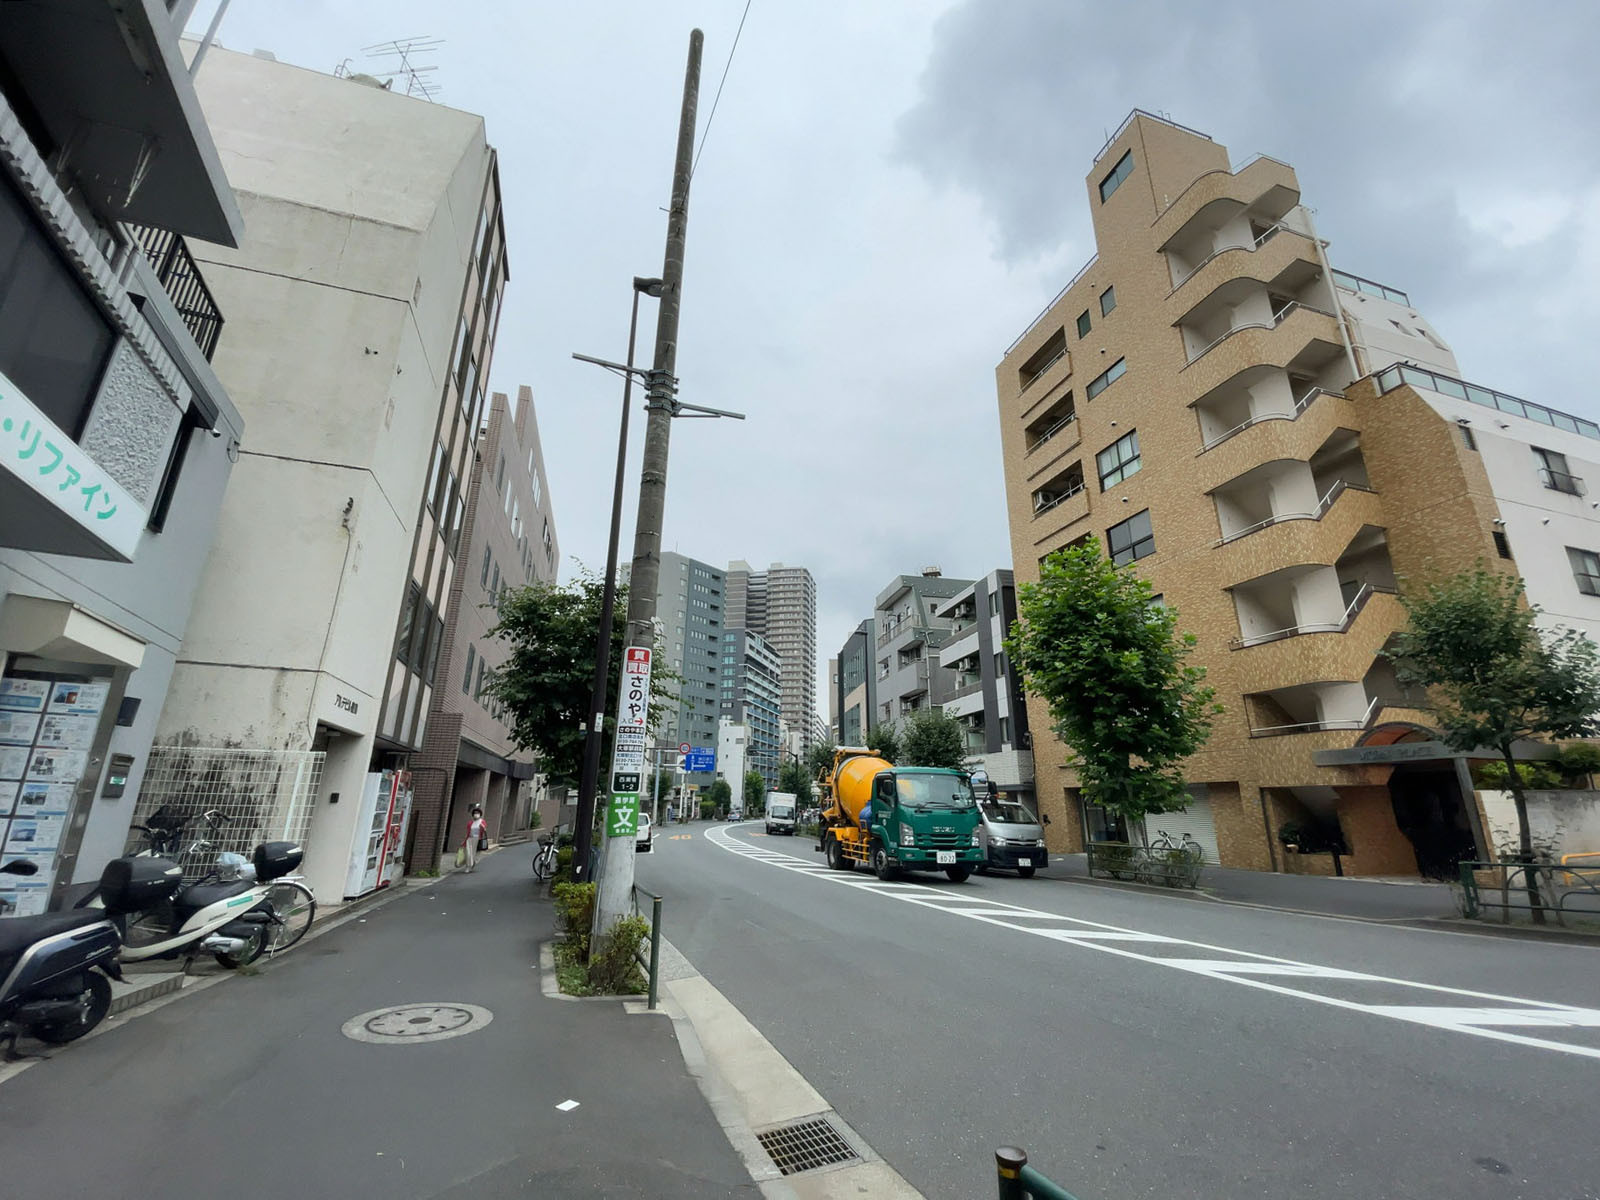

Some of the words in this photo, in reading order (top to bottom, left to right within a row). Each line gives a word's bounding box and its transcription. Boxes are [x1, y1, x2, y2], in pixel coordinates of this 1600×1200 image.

[0, 394, 117, 520] ・リファイン
[627, 662, 649, 673] 買取
[628, 676, 643, 717] さのや
[614, 796, 635, 804] 通学路
[613, 805, 634, 828] 文
